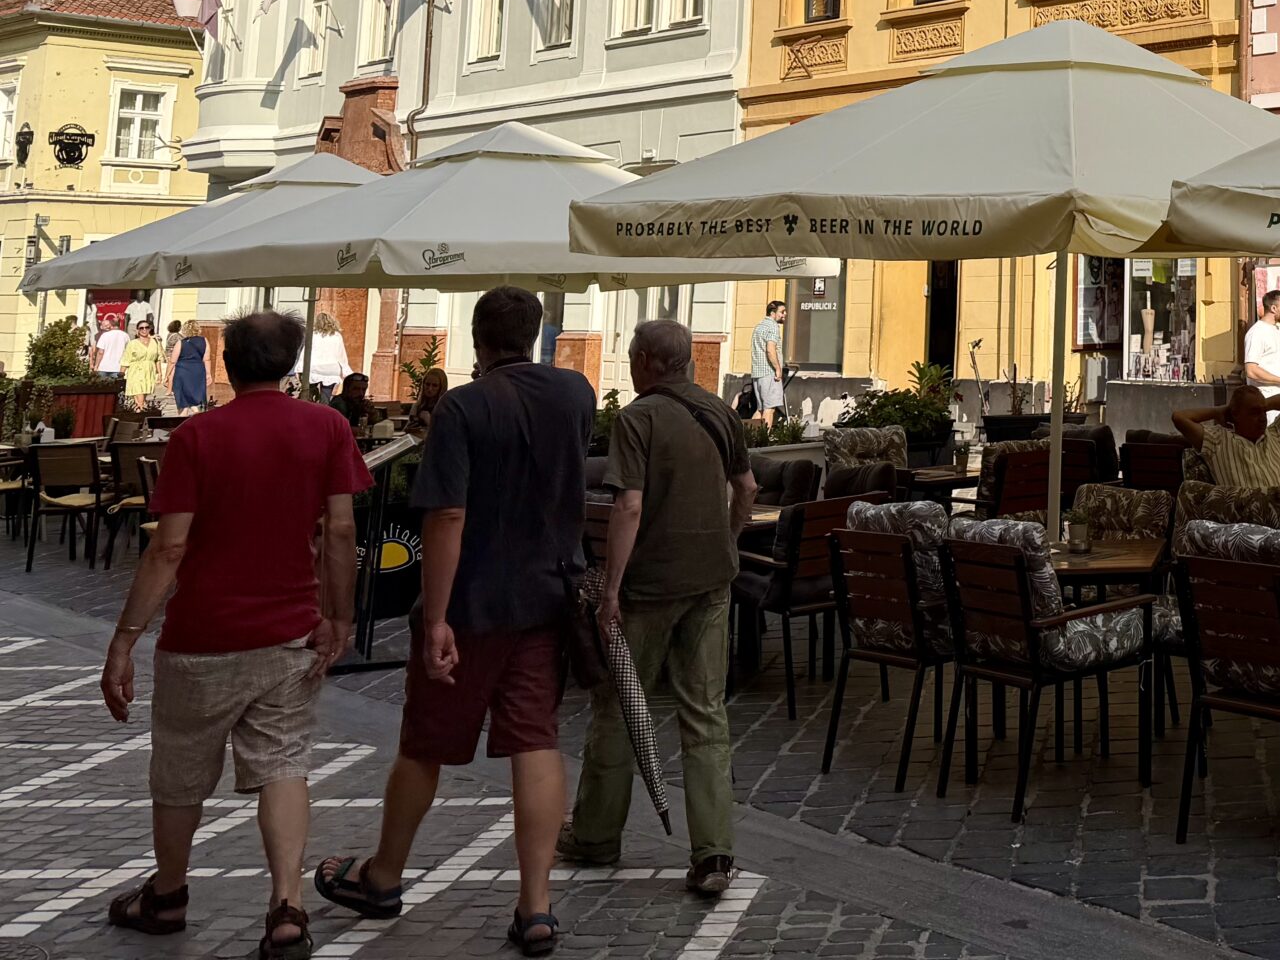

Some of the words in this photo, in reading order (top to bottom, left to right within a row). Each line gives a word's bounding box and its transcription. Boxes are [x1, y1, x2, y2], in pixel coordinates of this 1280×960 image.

[616, 222, 693, 236] PROBABLY
[700, 220, 727, 235] THE
[735, 218, 772, 233] BEST
[809, 218, 849, 233] BEER
[858, 219, 874, 235] IN
[884, 220, 913, 236] THE
[922, 220, 983, 236] WORLD
[800, 302, 831, 310] REPUBLICII
[832, 302, 837, 310] 2
